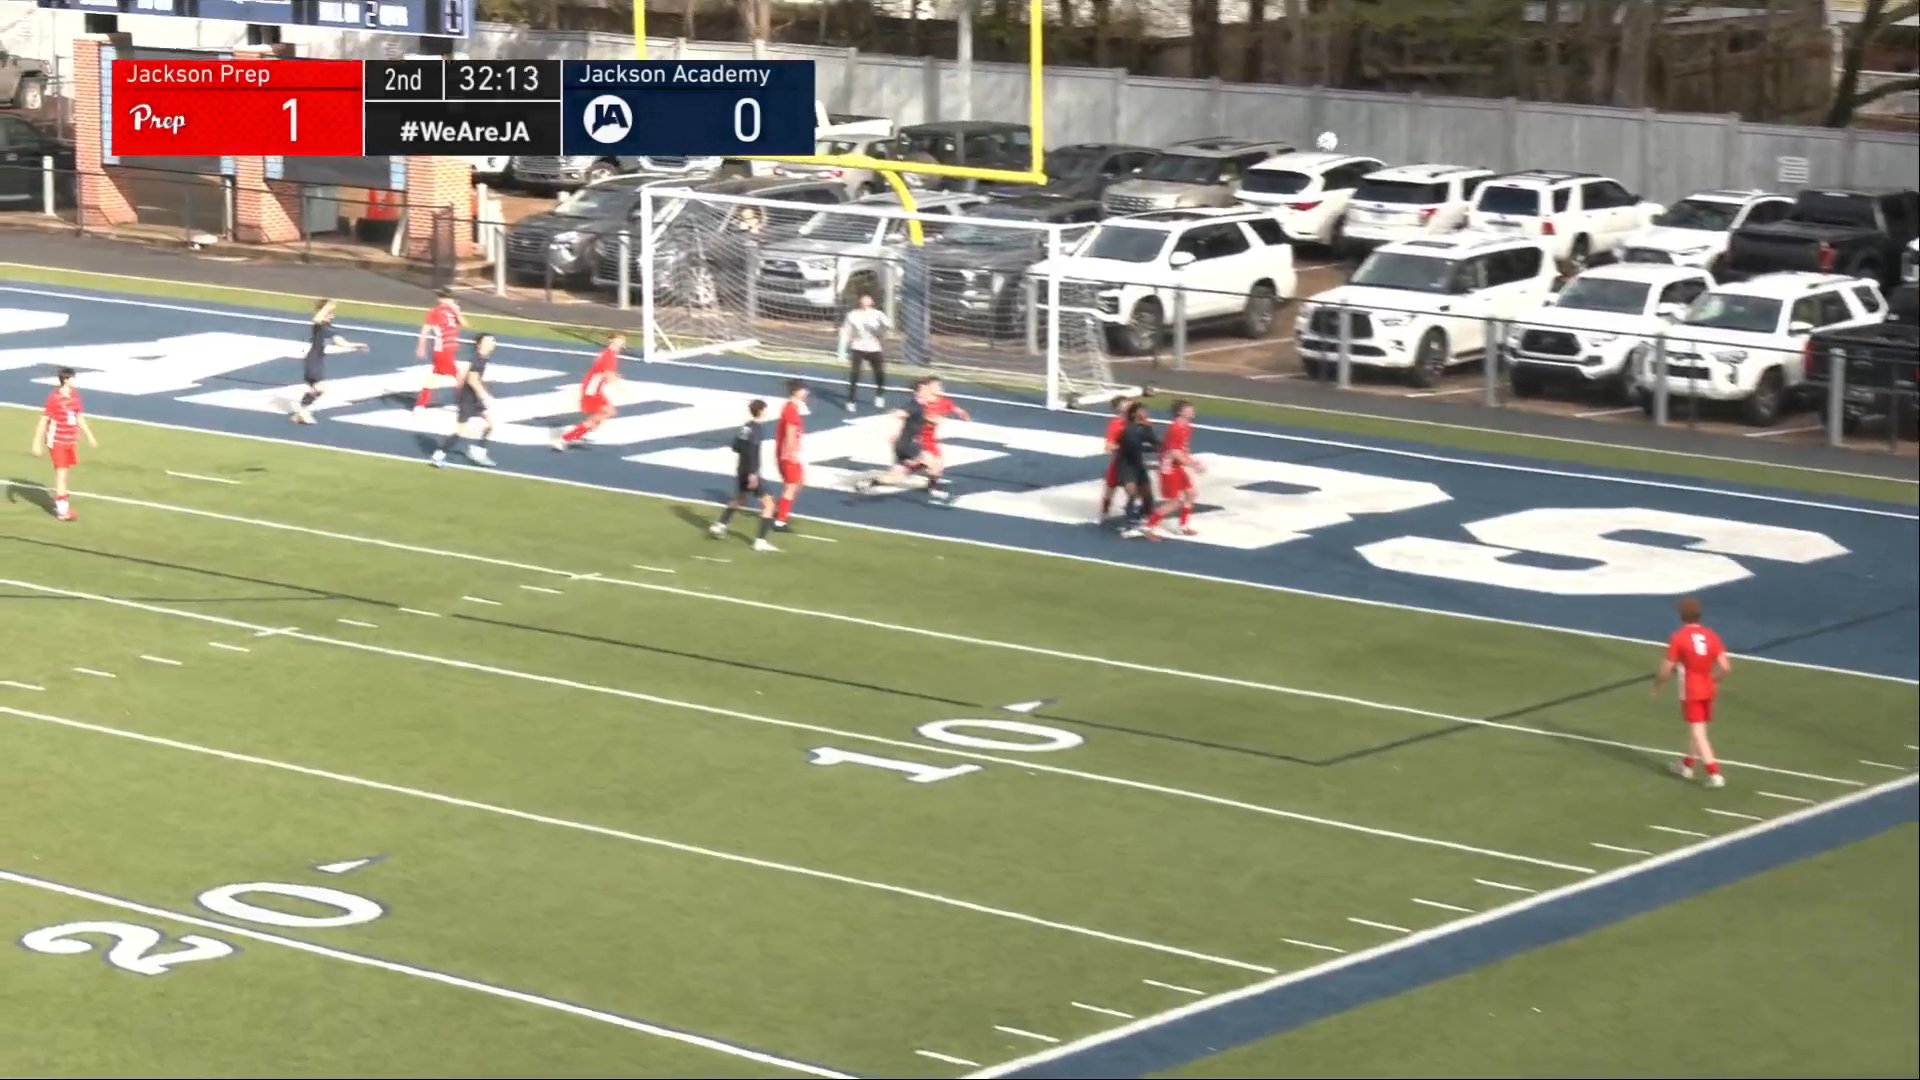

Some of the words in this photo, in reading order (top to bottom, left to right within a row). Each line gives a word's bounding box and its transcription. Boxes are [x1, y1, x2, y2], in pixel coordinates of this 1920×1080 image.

[0, 309, 1850, 595] AIDERS
[807, 718, 1085, 783] 10
[21, 881, 385, 976] 20
